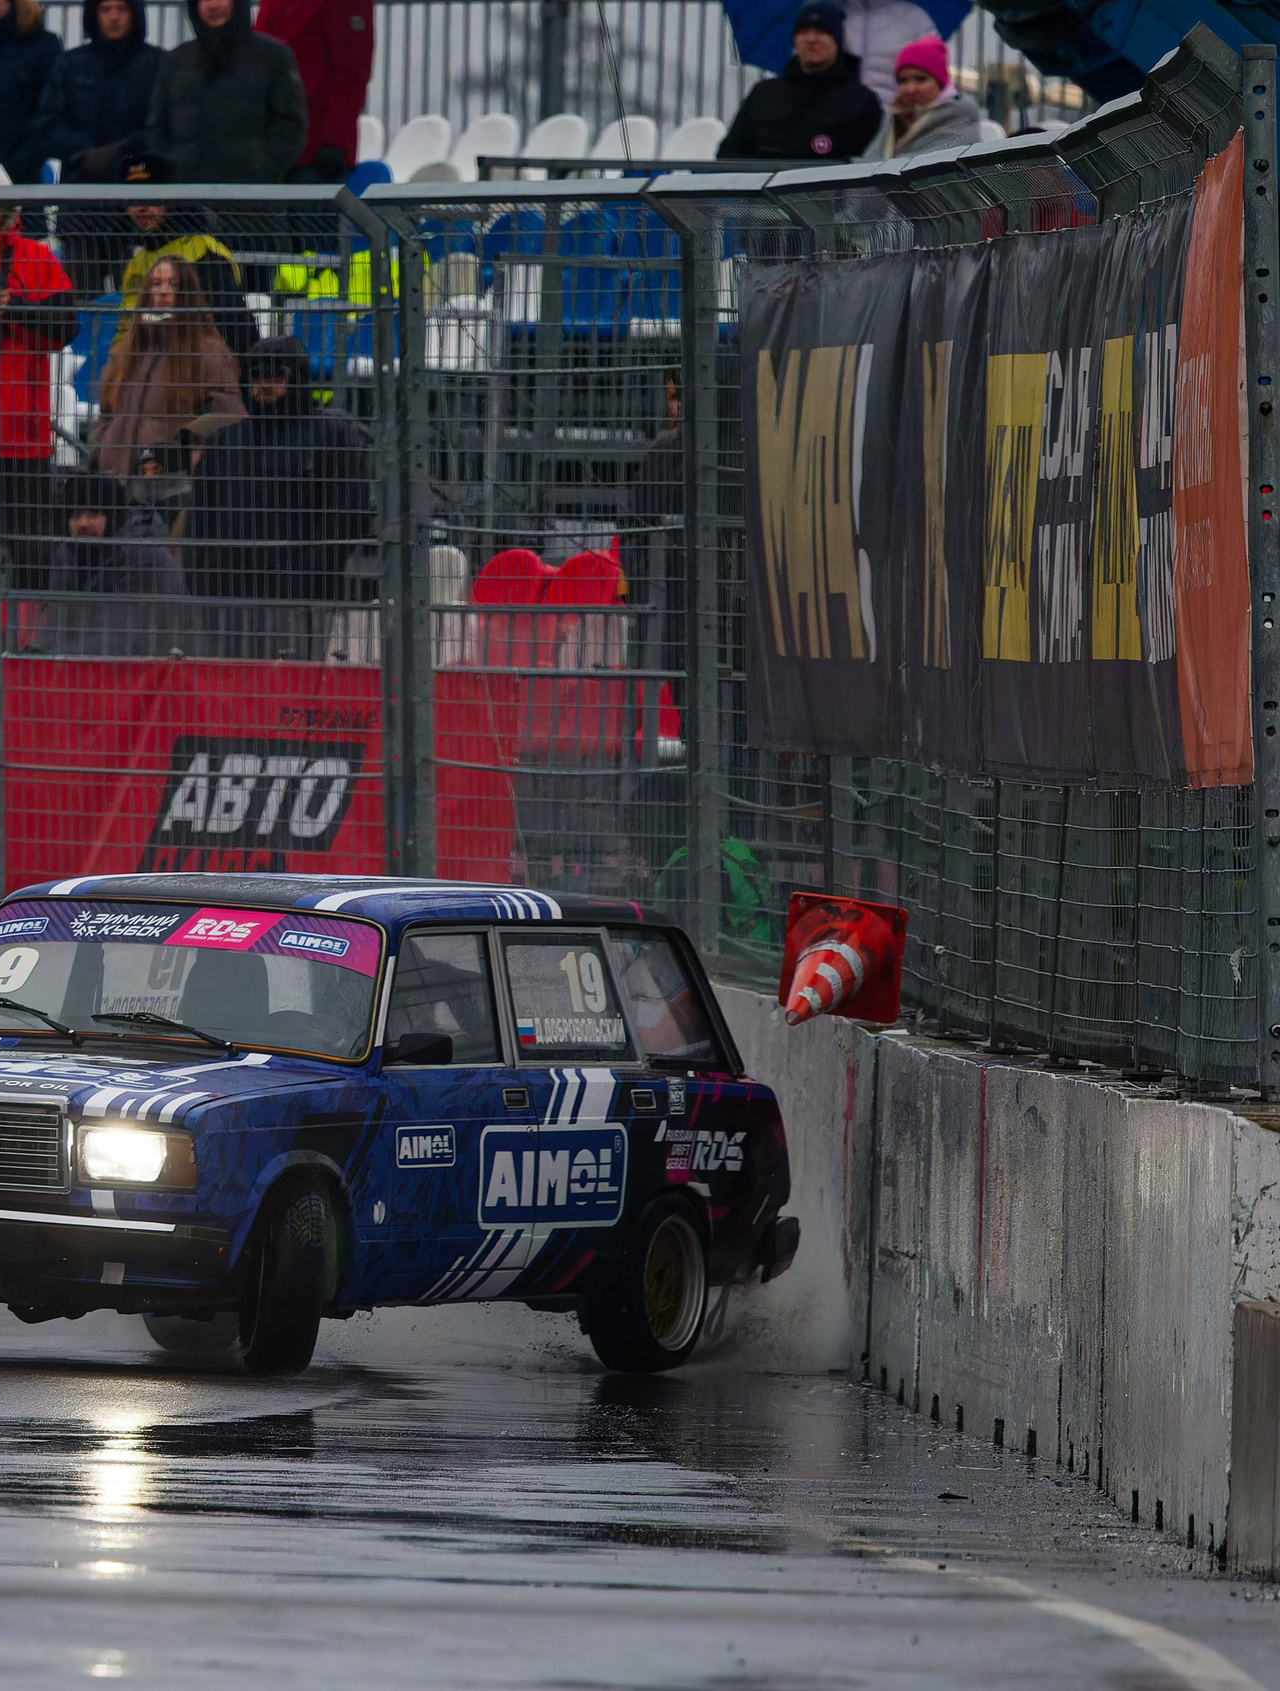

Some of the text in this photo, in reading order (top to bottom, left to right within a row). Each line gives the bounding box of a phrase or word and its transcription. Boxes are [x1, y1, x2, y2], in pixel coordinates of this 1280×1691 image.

[161, 752, 351, 838] АВТО
[92, 913, 180, 927] ЗИМНИЙ
[97, 925, 169, 938] КУБОК
[188, 918, 261, 939] RDS
[282, 933, 344, 953] AIMOL
[561, 952, 606, 1013] 19
[39, 1082, 71, 1092] OIL
[399, 1135, 453, 1160] AIMOL
[692, 1130, 747, 1171] RDS
[485, 1149, 619, 1207] AIMOL
